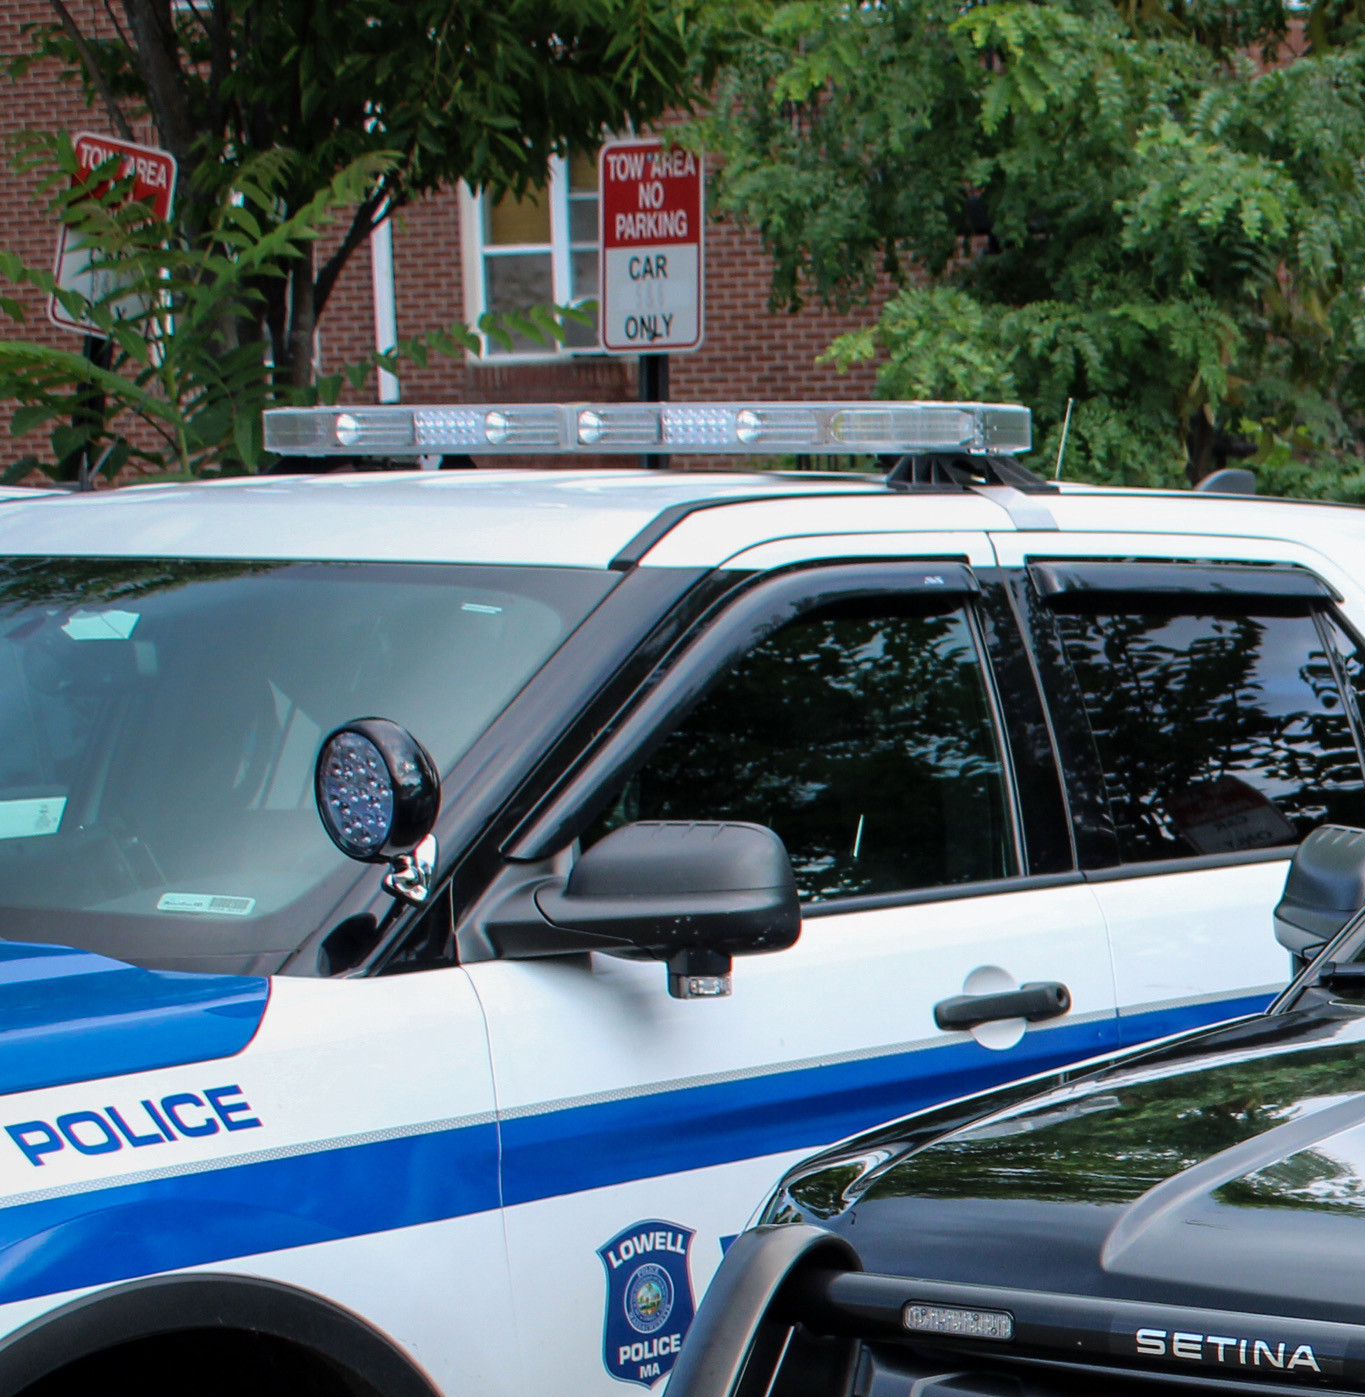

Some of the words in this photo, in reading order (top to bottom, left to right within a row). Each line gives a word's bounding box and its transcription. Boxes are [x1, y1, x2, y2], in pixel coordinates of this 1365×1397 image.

[607, 153, 645, 181] TOW
[650, 151, 696, 178] AREA
[638, 181, 664, 209] NO
[615, 209, 688, 240] PARKING
[628, 254, 668, 280] CAR
[624, 313, 674, 340] ONLY
[4, 1084, 263, 1167] POLICE
[607, 1231, 686, 1269] LOWELL
[619, 1334, 682, 1365] POLICE
[1135, 1328, 1321, 1372] SETINA
[639, 1363, 661, 1379] MA
